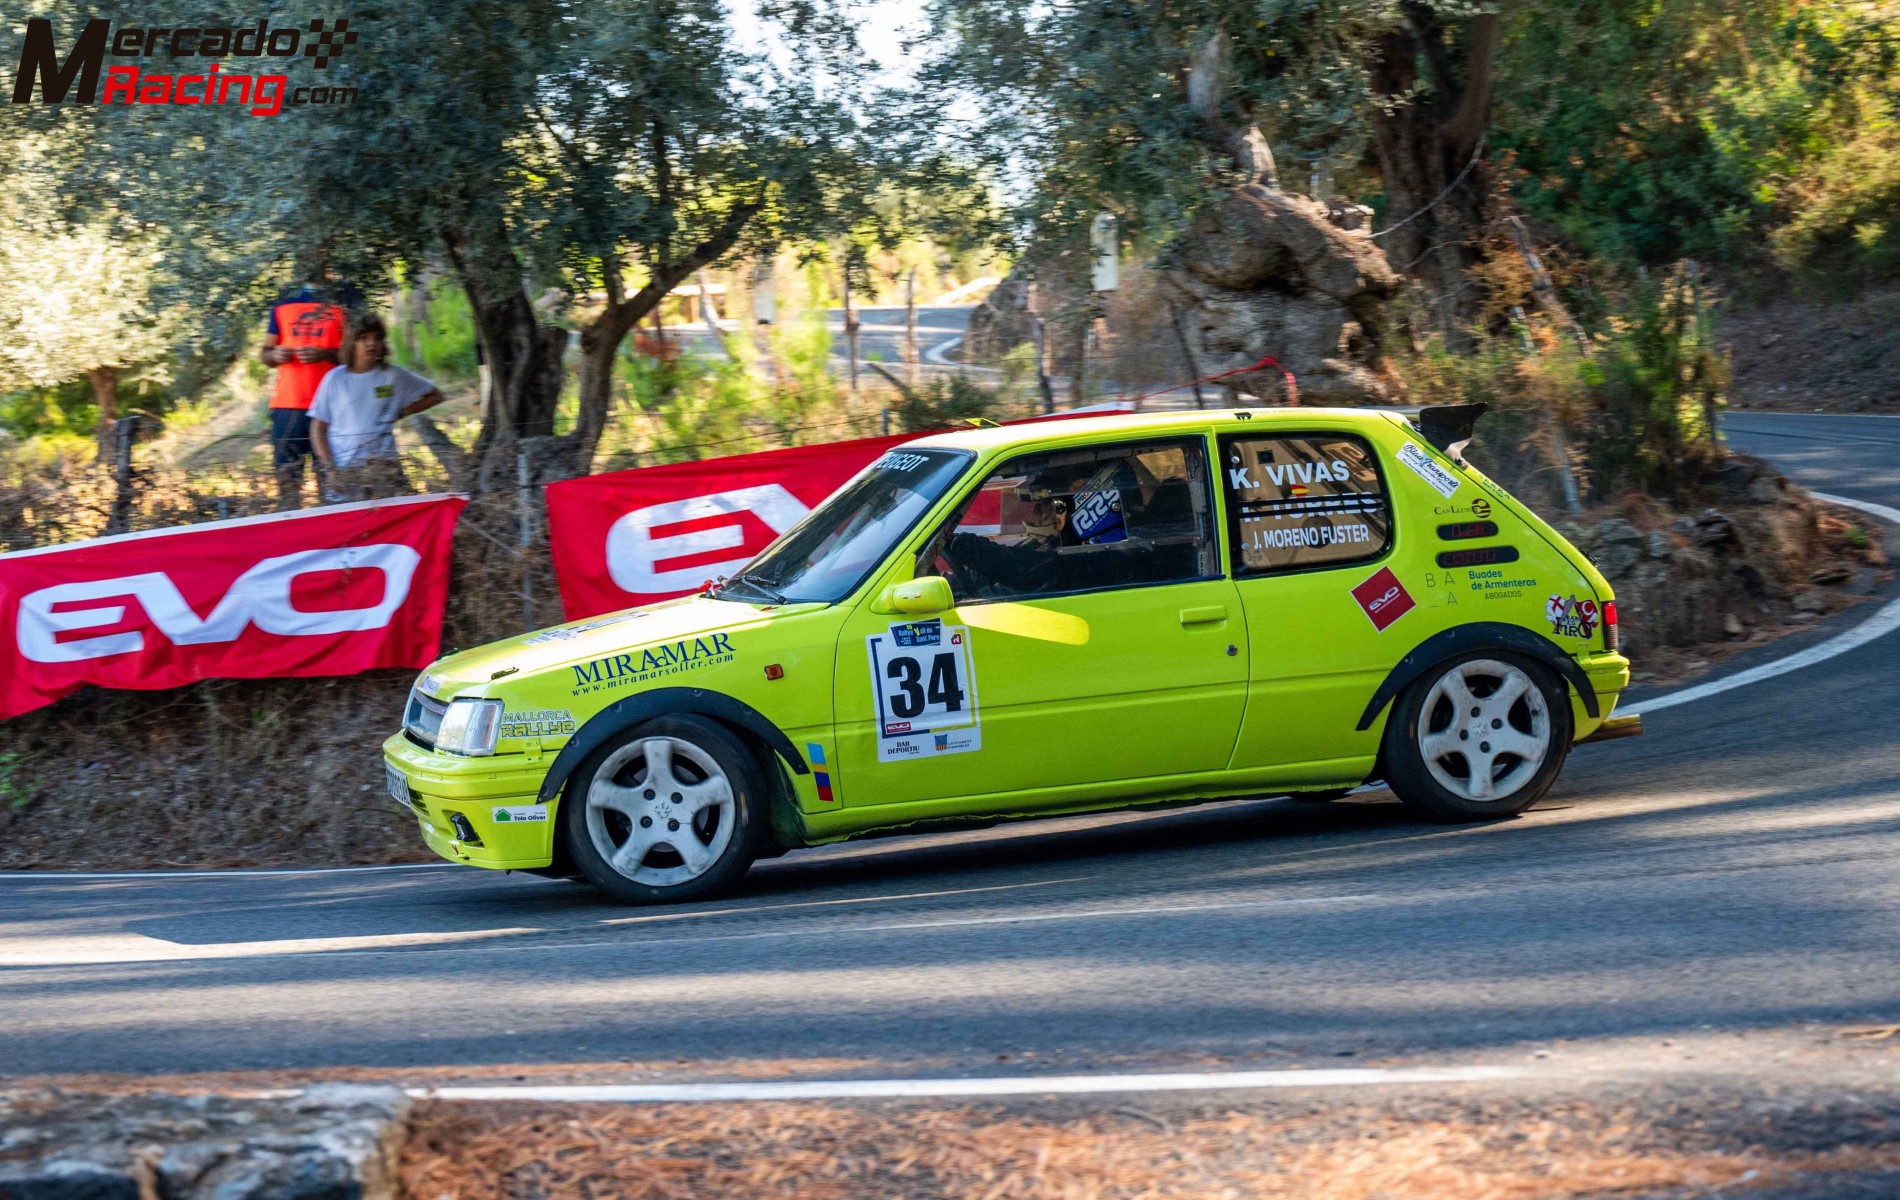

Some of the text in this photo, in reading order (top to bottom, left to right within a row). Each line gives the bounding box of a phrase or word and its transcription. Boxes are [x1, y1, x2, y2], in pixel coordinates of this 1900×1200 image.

[1229, 460, 1350, 490] K. VIVAS
[1253, 523, 1370, 549] J. MORENO FUSTER
[1469, 570, 1503, 580] Buades
[1471, 578, 1537, 590] de Armenteras
[16, 544, 421, 663] EVO
[1368, 585, 1399, 611] EVO
[1484, 590, 1522, 600] ABOGADOS
[571, 632, 737, 687] MIRAMAR
[571, 654, 734, 697] www.miramarsoller.com
[887, 652, 964, 718] 34
[503, 710, 572, 722] MALLORCA
